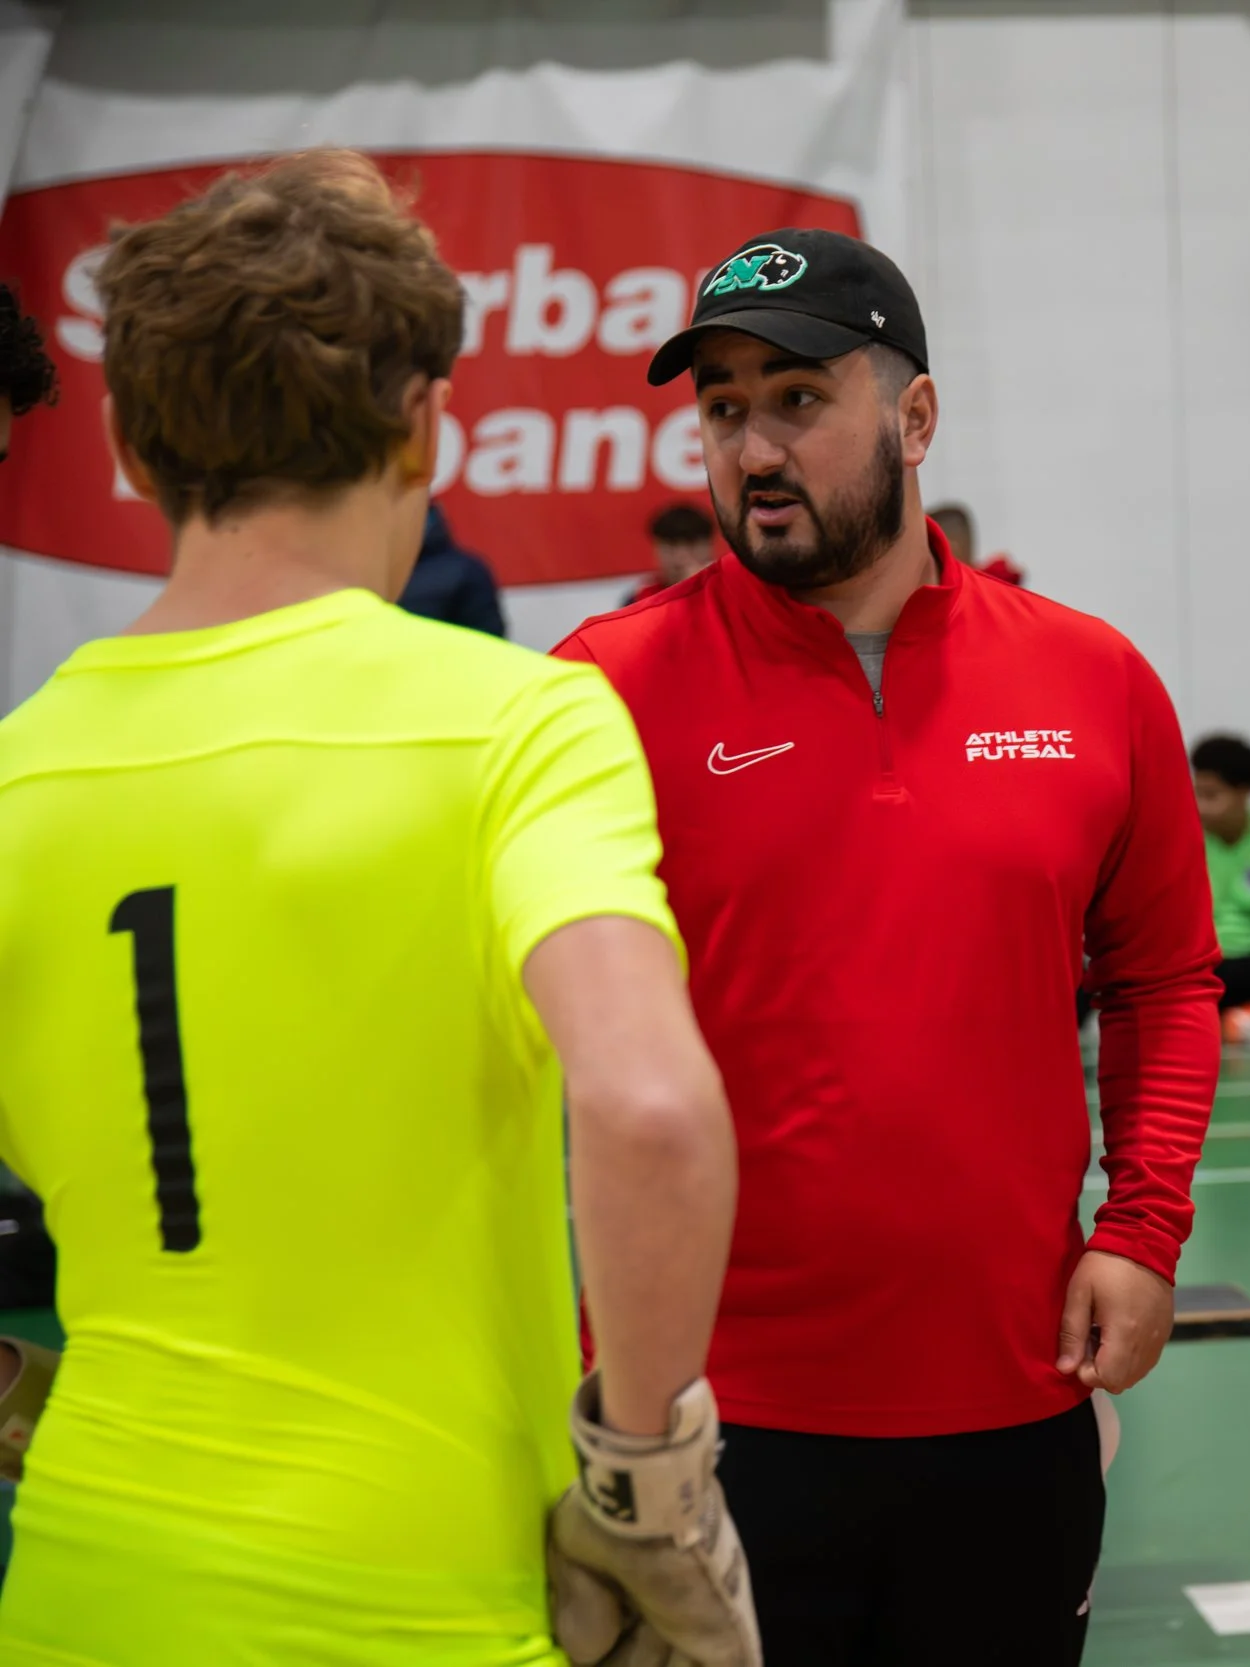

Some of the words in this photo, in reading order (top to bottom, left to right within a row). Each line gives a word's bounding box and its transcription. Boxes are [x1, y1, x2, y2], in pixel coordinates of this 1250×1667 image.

[965, 730, 1073, 746] ATHLETIC
[966, 744, 1076, 762] FUTSAL
[108, 884, 203, 1254] 1
